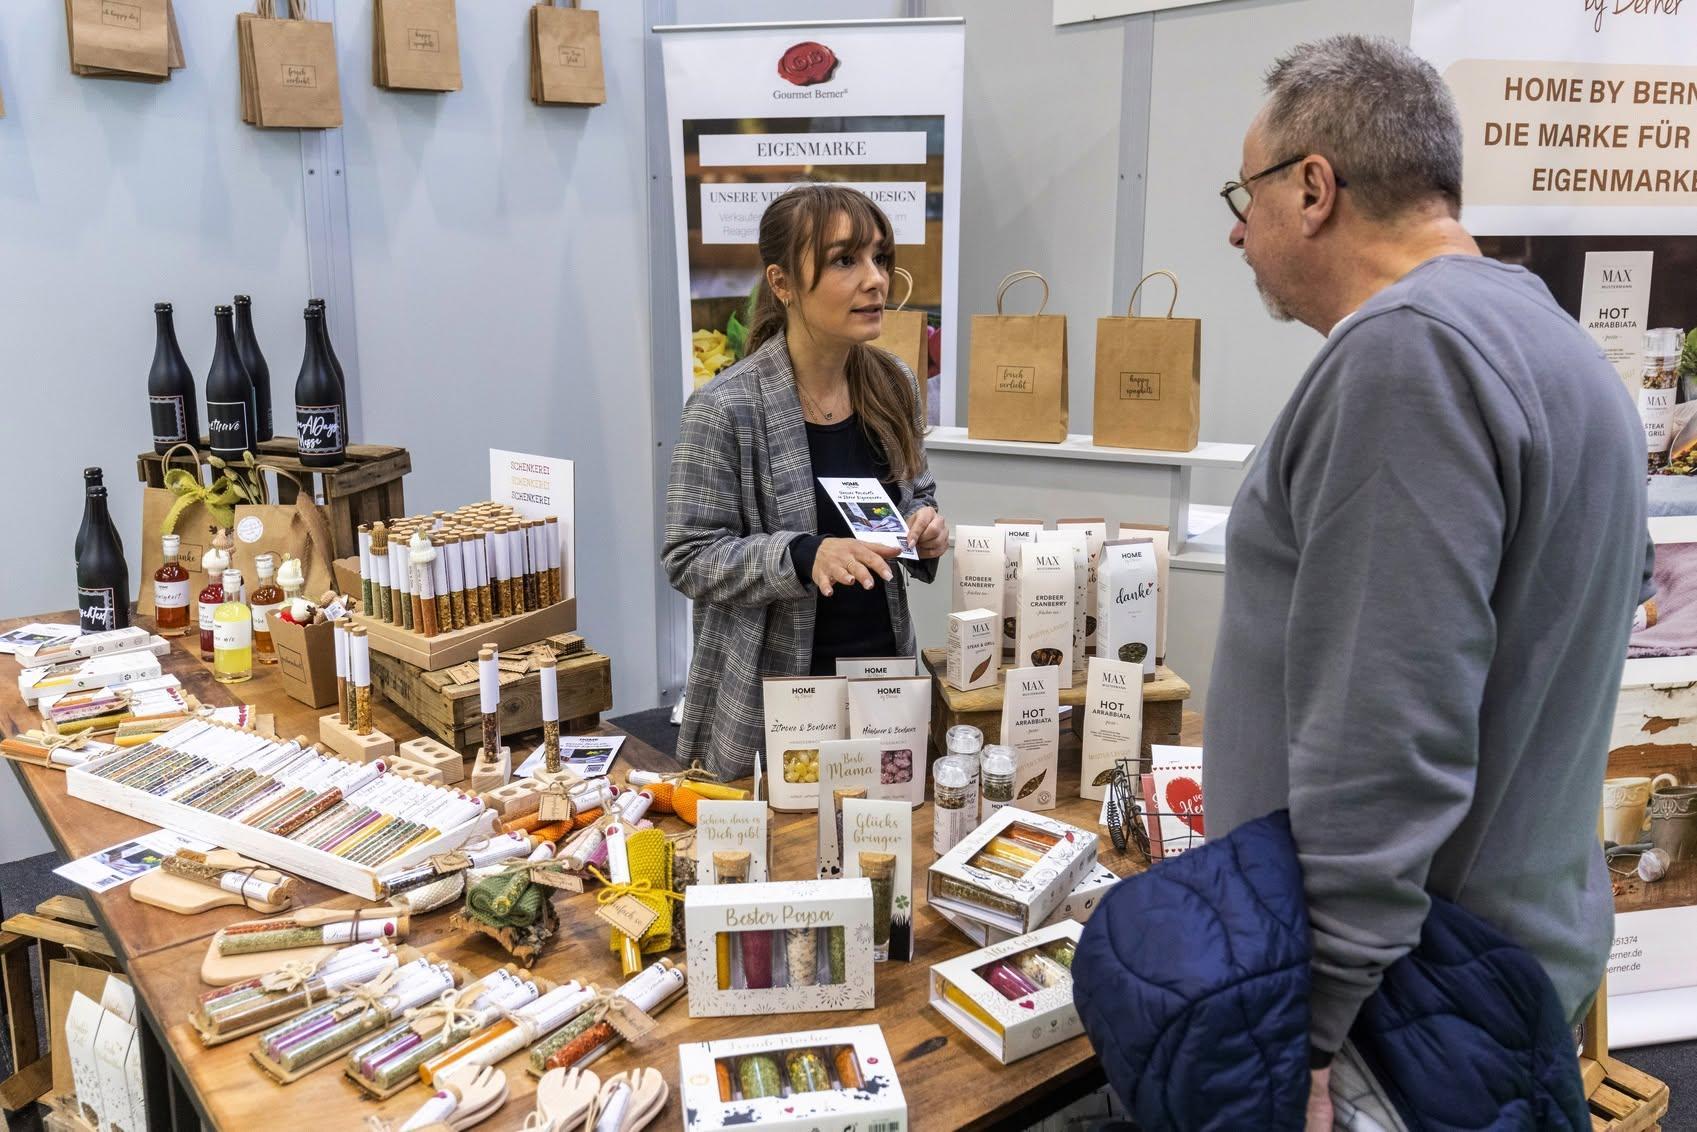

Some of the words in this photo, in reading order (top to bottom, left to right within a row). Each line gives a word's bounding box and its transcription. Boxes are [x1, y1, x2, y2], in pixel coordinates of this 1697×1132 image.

[772, 90, 812, 100] Gourmet
[1504, 77, 1583, 102] HOME
[1589, 79, 1625, 104] BY
[1484, 122, 1529, 146] DIE
[1538, 123, 1629, 148] MARKE
[1638, 120, 1690, 149] FÜR
[757, 141, 867, 157] EIGENMARKE
[709, 191, 757, 203] UNSERE
[869, 190, 918, 202] DESIGN
[1602, 269, 1633, 283] MAX
[1599, 307, 1630, 319] HOT
[1588, 321, 1637, 329] ARRABBIATA
[1647, 396, 1667, 406] MAX
[511, 490, 551, 505] SCHENKEREI
[967, 539, 991, 549] MAX
[1036, 556, 1060, 566] MAX
[1121, 551, 1143, 559] HOME
[1115, 582, 1152, 605] danke
[972, 622, 990, 633] MAX
[1102, 671, 1126, 686] MAX
[791, 687, 816, 695] HOME
[877, 687, 901, 695] HOME
[1022, 679, 1045, 692] MAX
[1100, 700, 1125, 712] HOT
[1022, 708, 1046, 719] HOT
[1092, 708, 1131, 720] ARRABBIATA
[1015, 717, 1052, 726] ARRABBIATA
[828, 761, 873, 780] Mama
[726, 906, 778, 926] Bester
[782, 904, 834, 929] Papa
[1608, 949, 1643, 960] erner.de
[1607, 962, 1641, 974] erner.de
